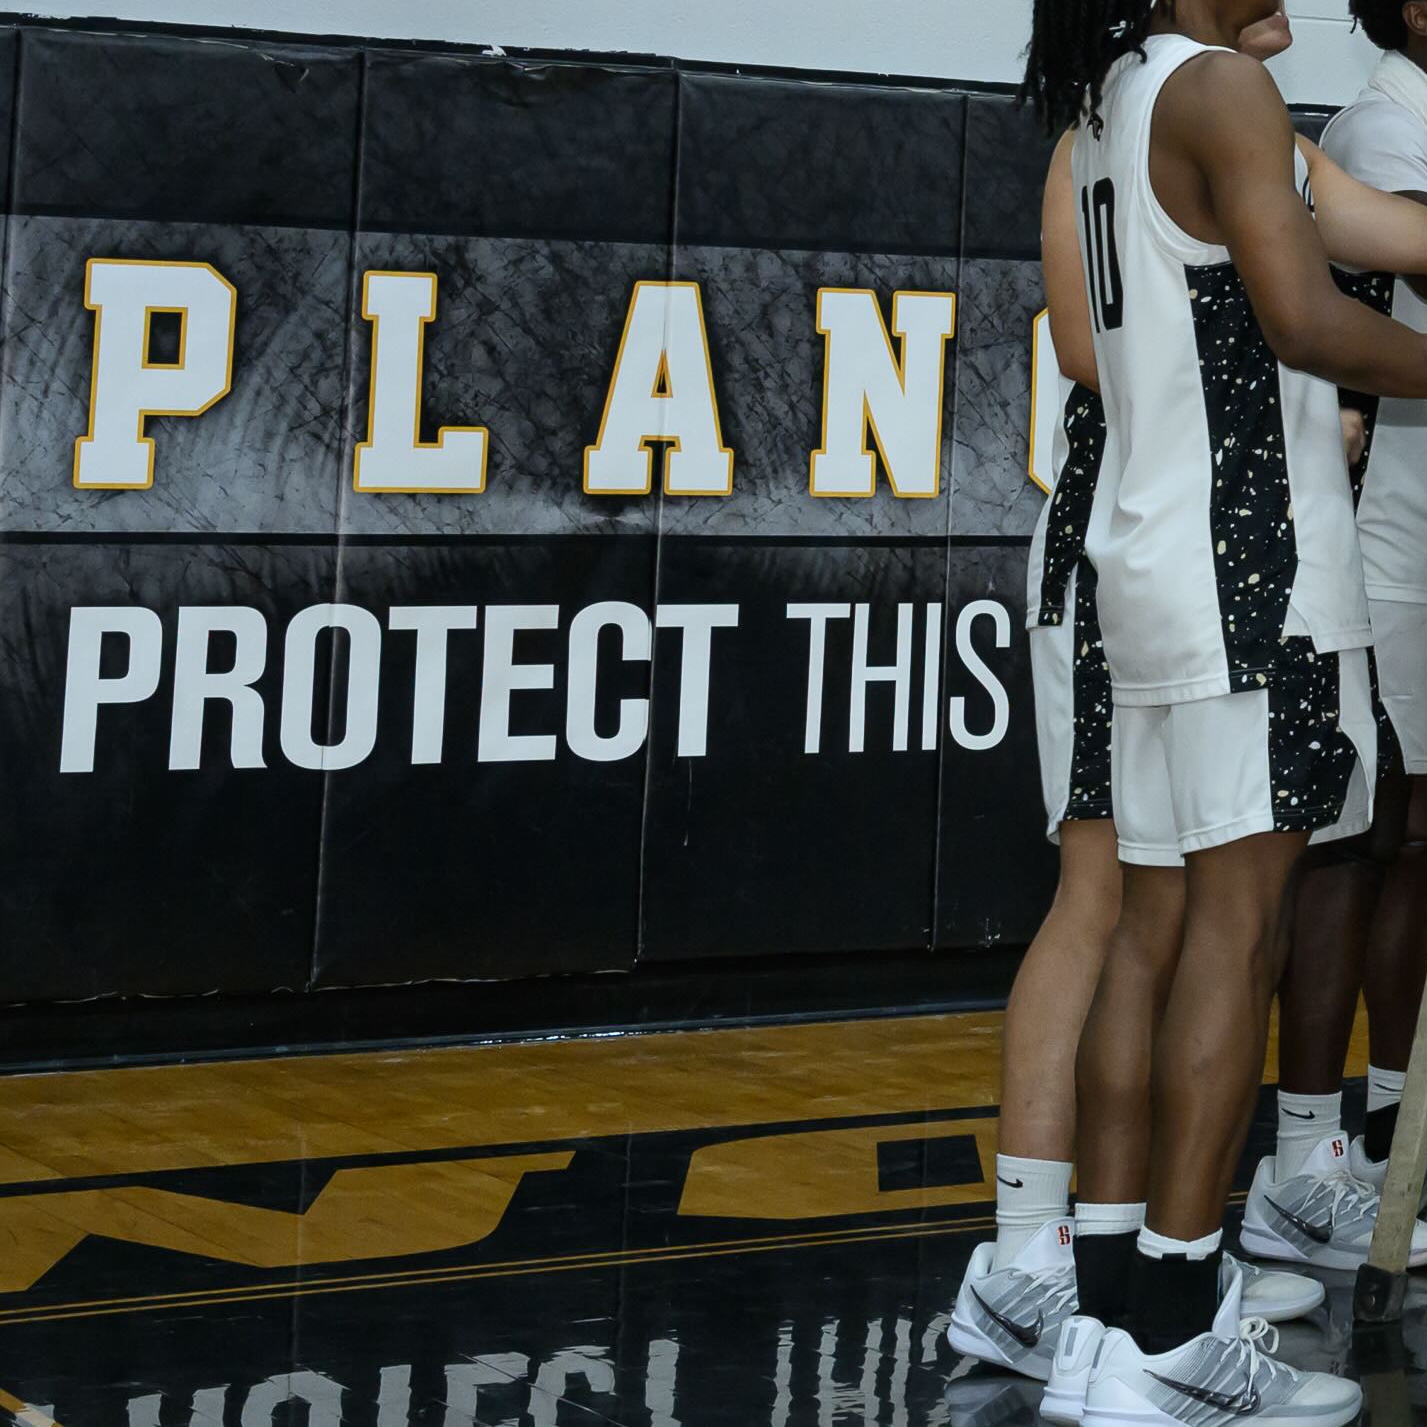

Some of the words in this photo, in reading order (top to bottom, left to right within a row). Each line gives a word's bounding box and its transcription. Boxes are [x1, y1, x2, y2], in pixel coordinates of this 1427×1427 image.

[1081, 176, 1124, 334] 10
[72, 257, 1058, 499] PLAN
[59, 599, 740, 774] PROTECT
[785, 599, 1011, 756] THIS
